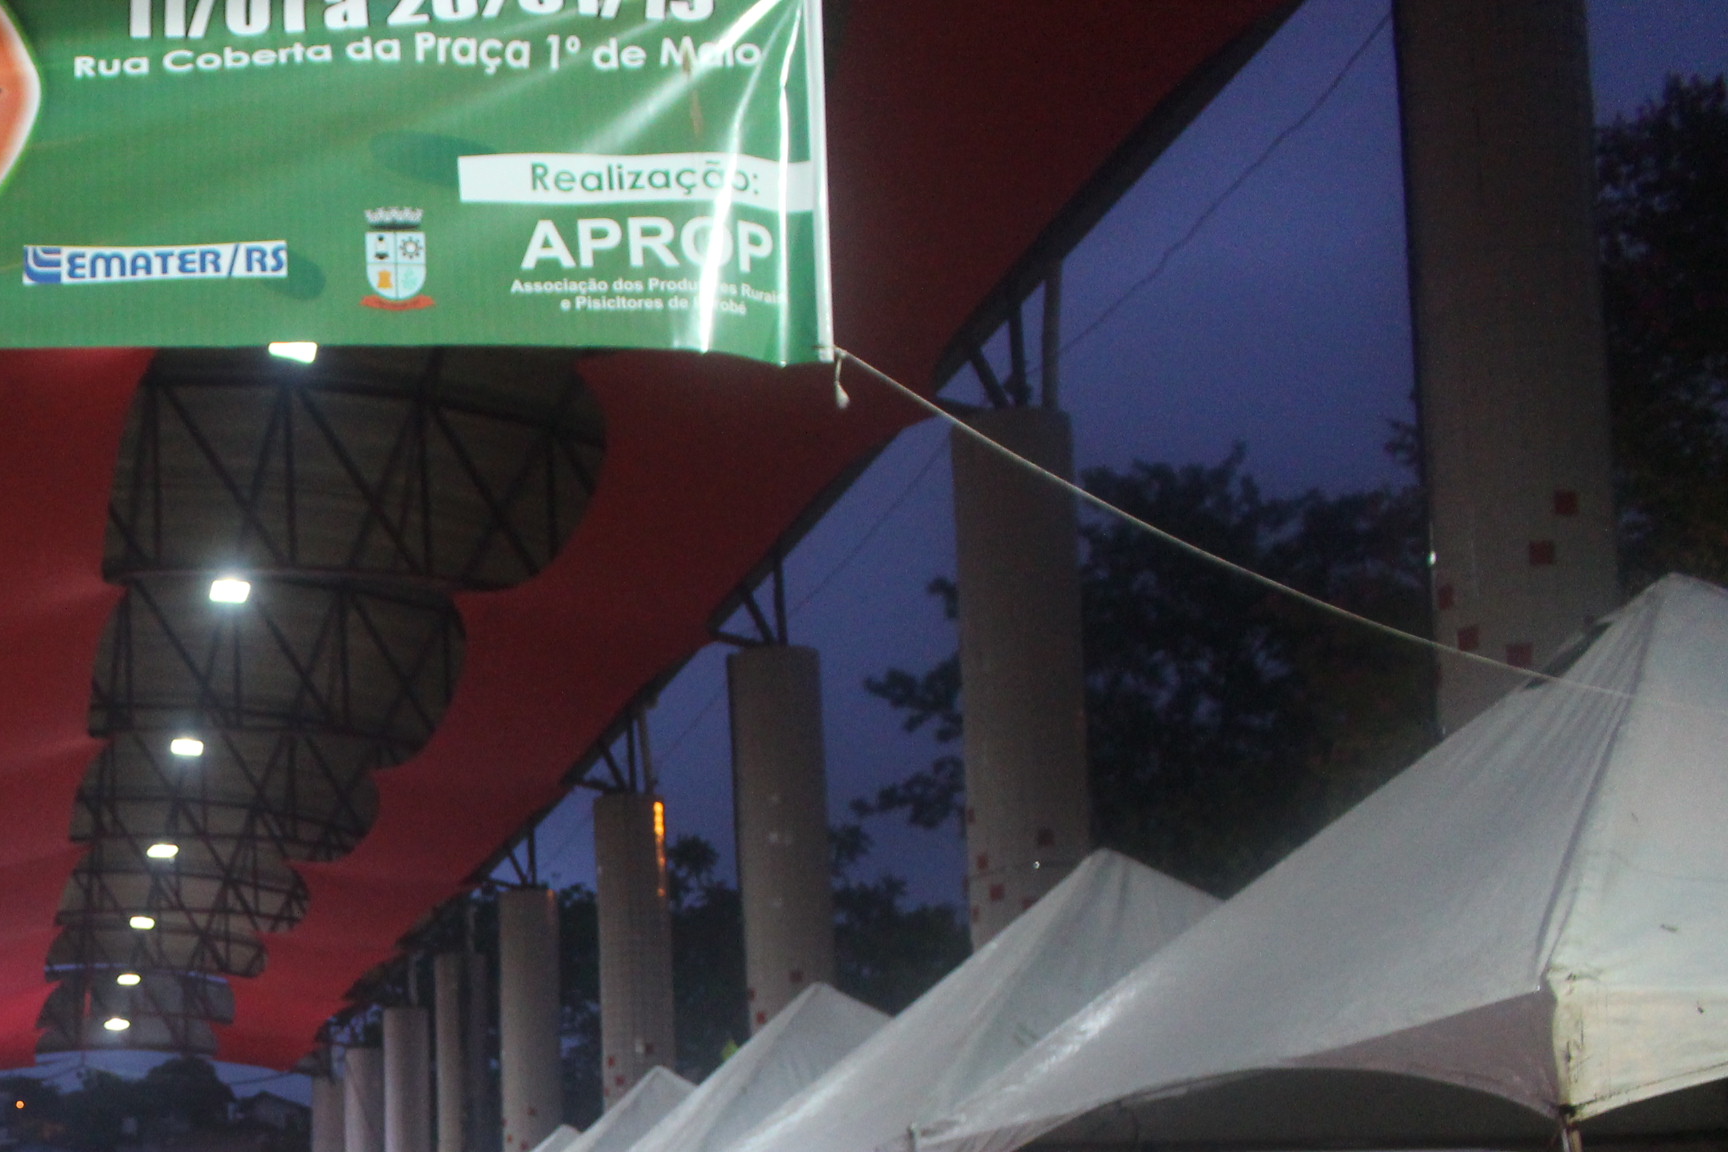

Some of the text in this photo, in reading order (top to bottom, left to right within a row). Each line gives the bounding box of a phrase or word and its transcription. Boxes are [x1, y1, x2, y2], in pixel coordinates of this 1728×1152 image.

[74, 31, 762, 79] Rua Coberta da Praça 1º de Maio
[530, 159, 760, 196] Realização:
[66, 243, 286, 279] EMATER/RS
[520, 216, 773, 273] APROP
[510, 278, 609, 295] Associação
[612, 277, 644, 292] dos
[560, 298, 572, 312] e
[668, 295, 689, 311] de
